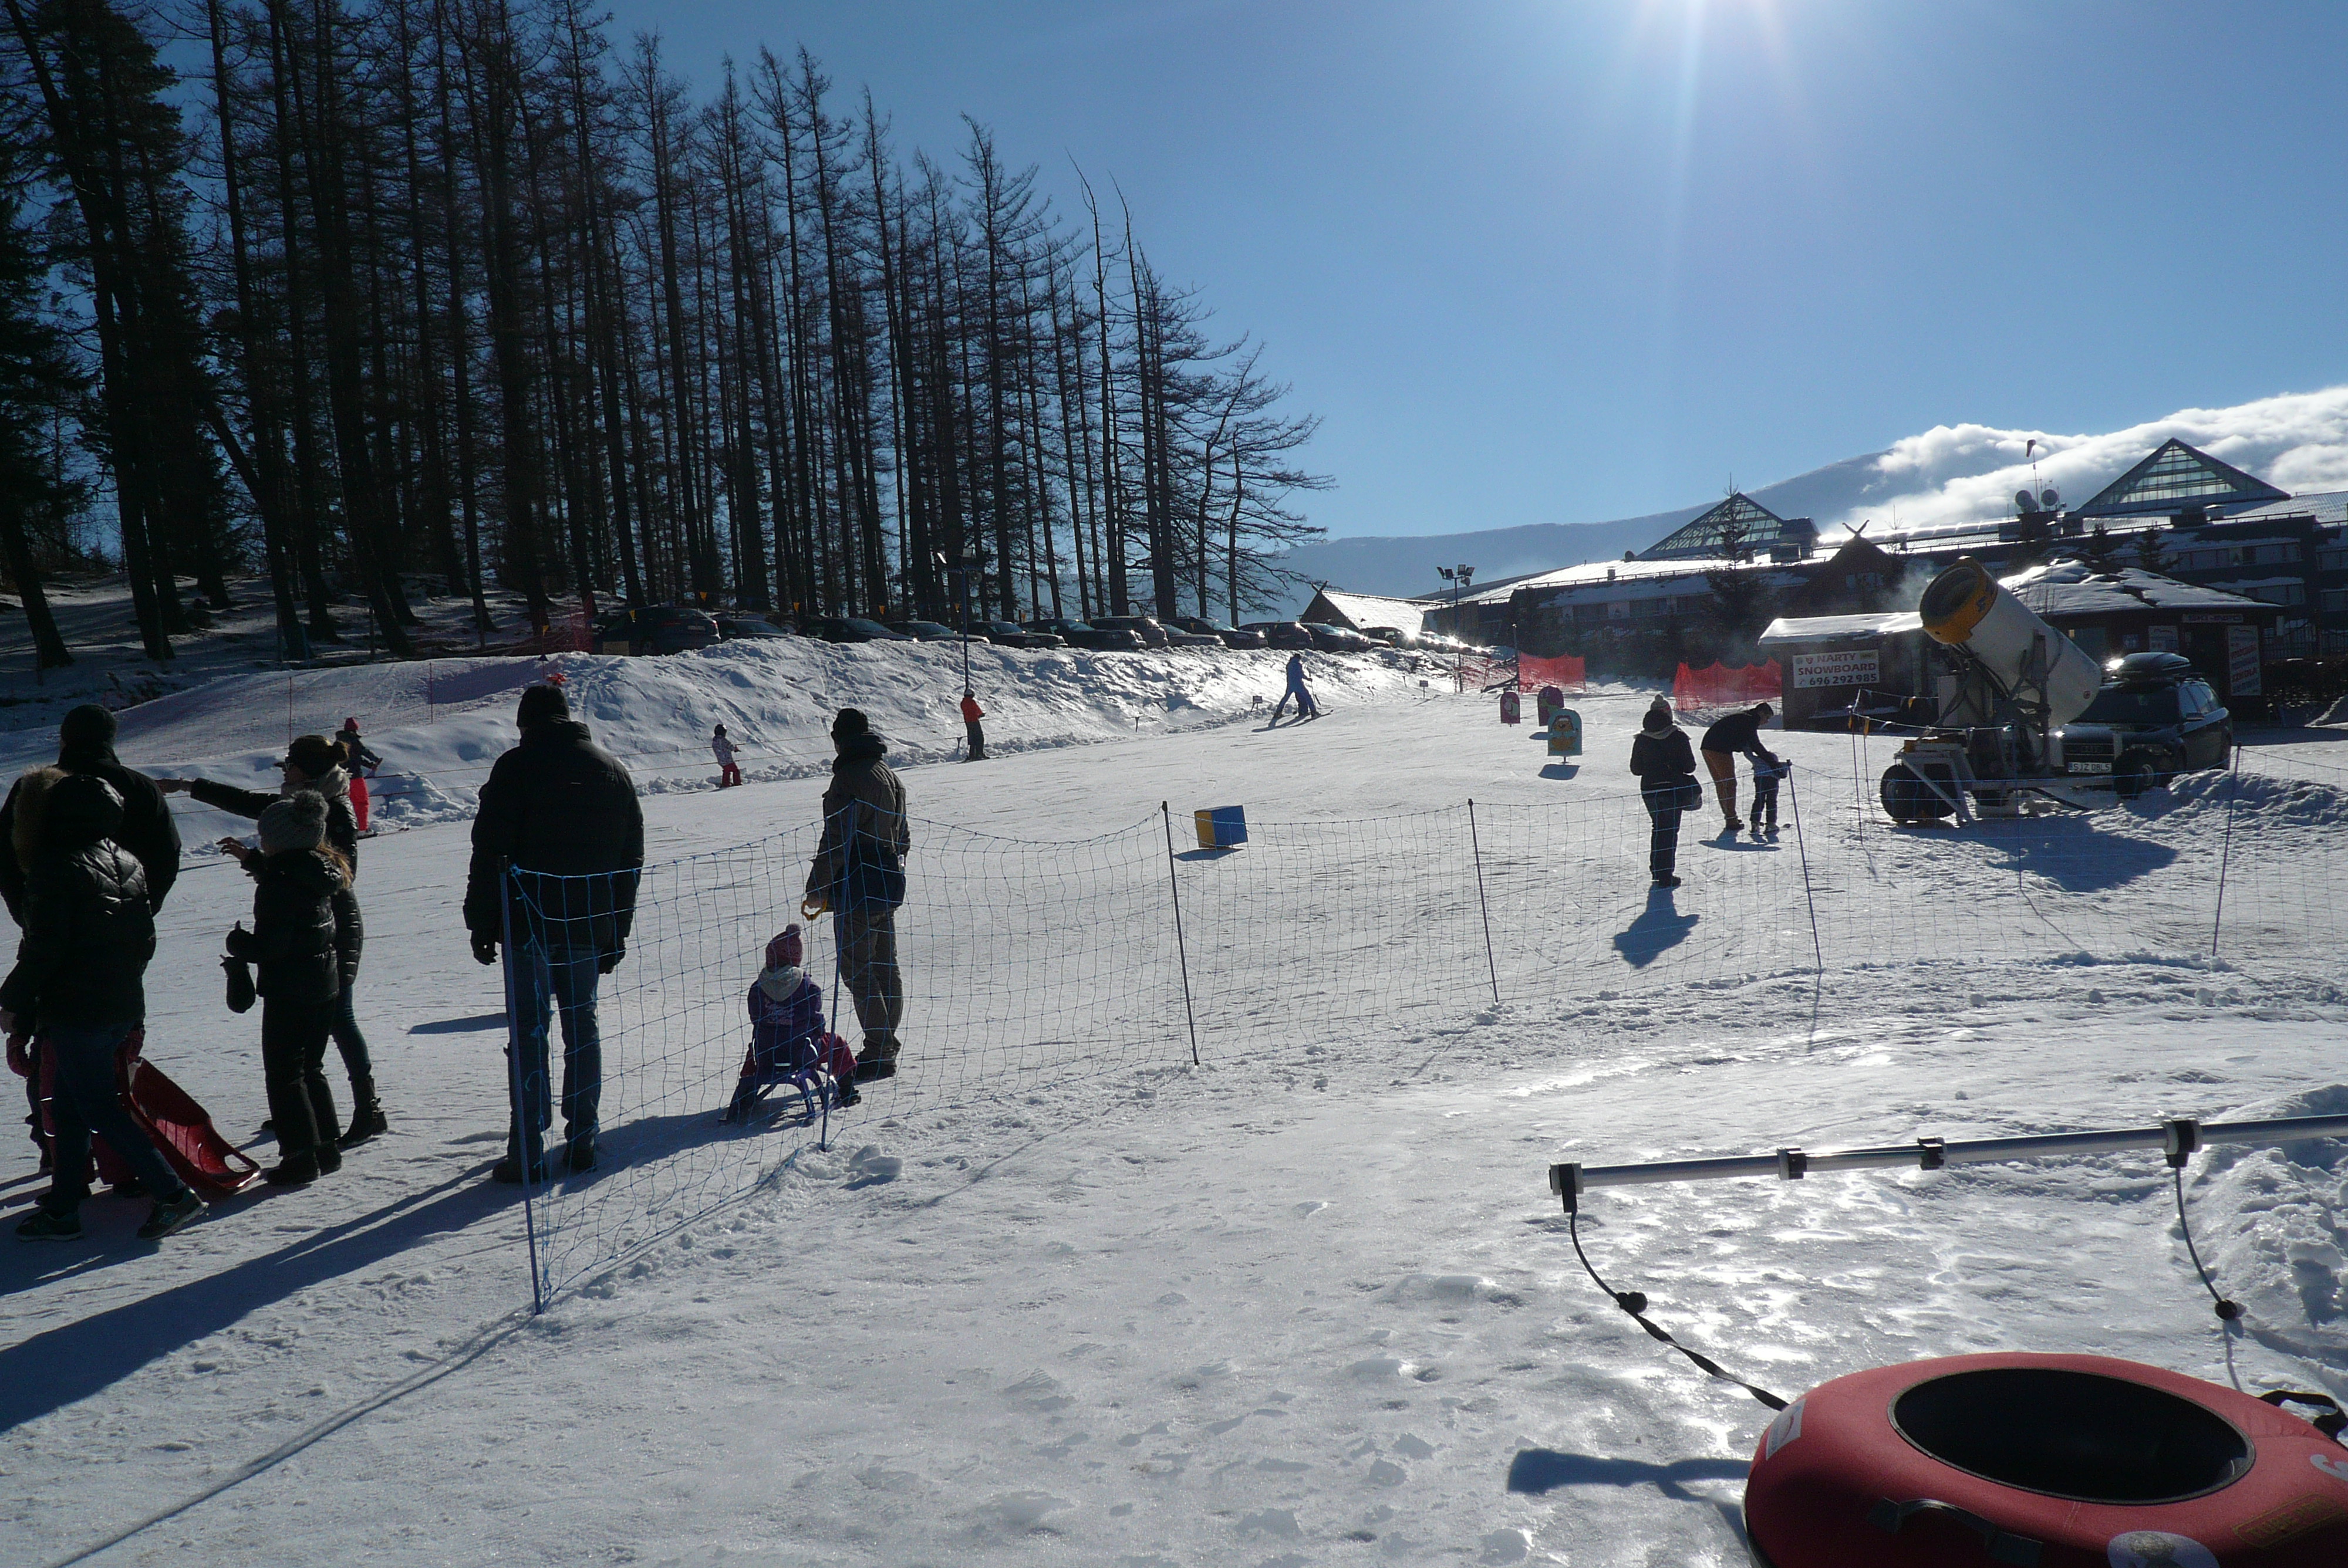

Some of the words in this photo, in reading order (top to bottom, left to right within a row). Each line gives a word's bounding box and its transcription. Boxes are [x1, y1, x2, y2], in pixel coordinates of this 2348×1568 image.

[1817, 653, 1856, 663] NARTY
[1798, 663, 1876, 675] SNOWBOARD
[1810, 677, 1830, 685] 696
[1833, 675, 1854, 684] 292
[1856, 674, 1877, 682] 985
